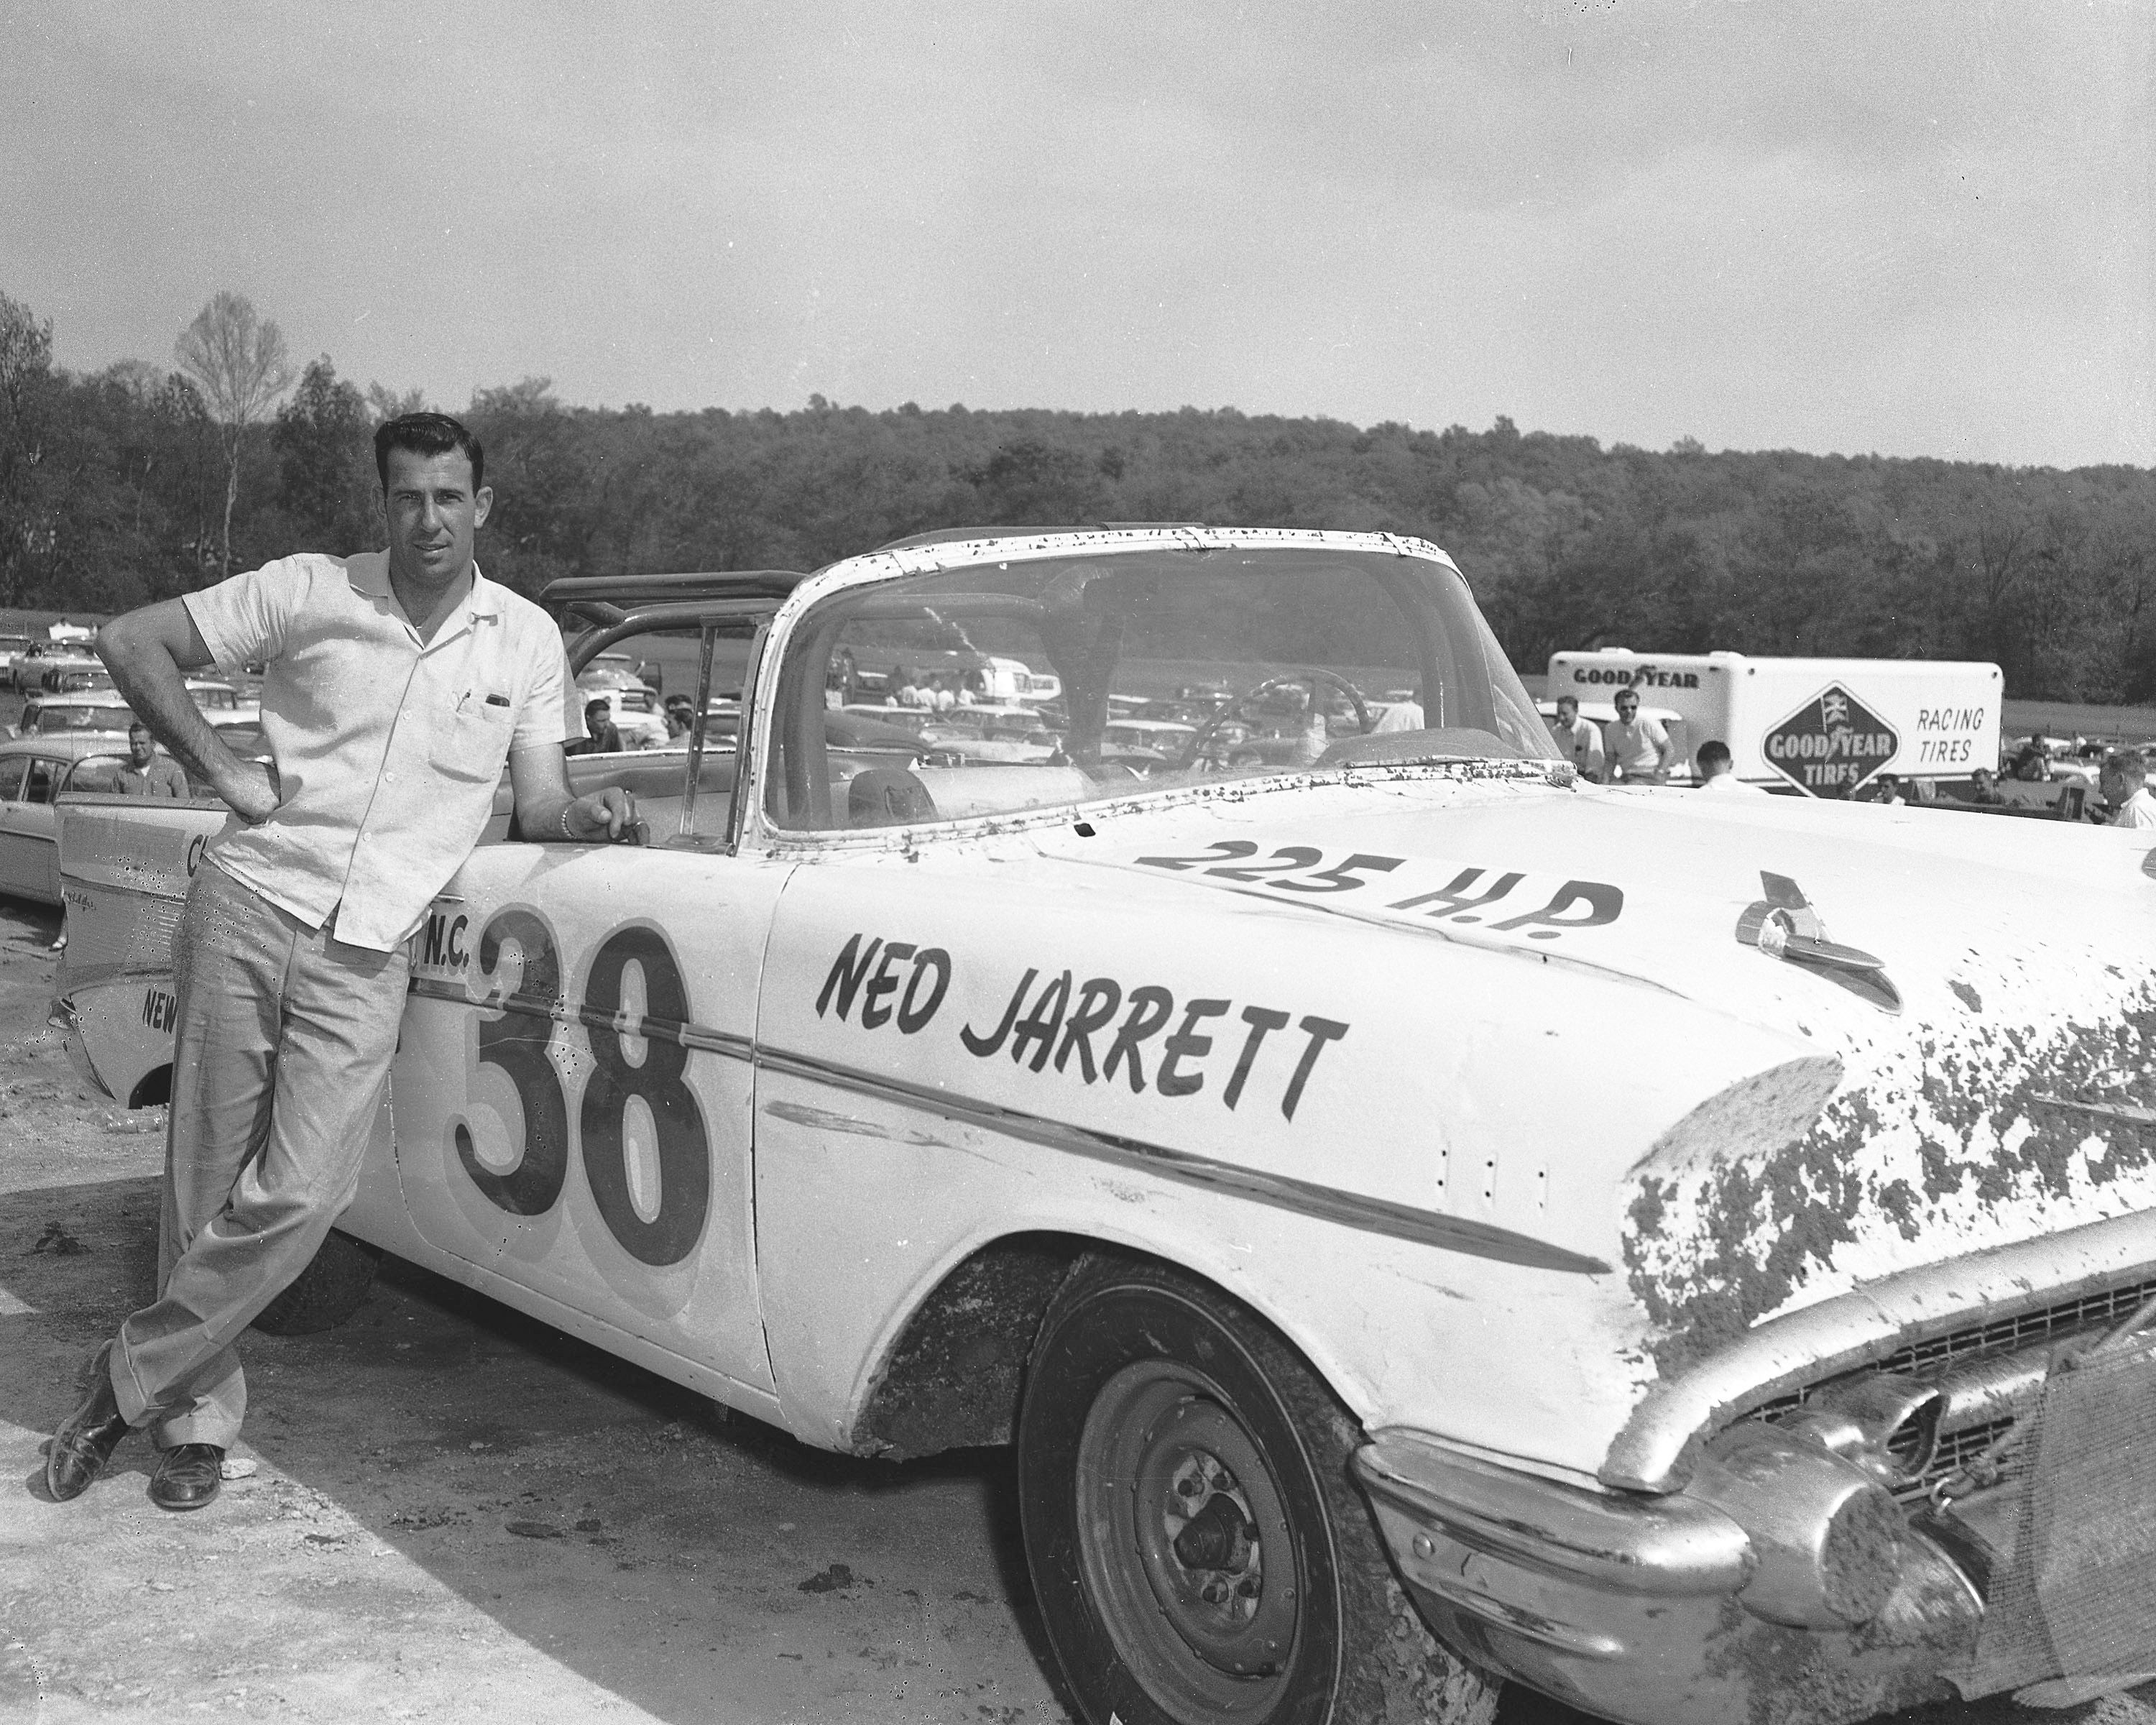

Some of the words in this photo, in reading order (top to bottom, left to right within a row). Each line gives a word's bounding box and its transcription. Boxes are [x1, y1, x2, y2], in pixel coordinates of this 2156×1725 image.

[1917, 708, 1984, 731] RACING
[1920, 739, 1971, 763] TIRES
[1133, 840, 1406, 893] 225
[424, 915, 469, 968] N.C.
[816, 934, 950, 1034] NED
[959, 969, 1350, 1122] JARRETT
[455, 910, 710, 1266] 38
